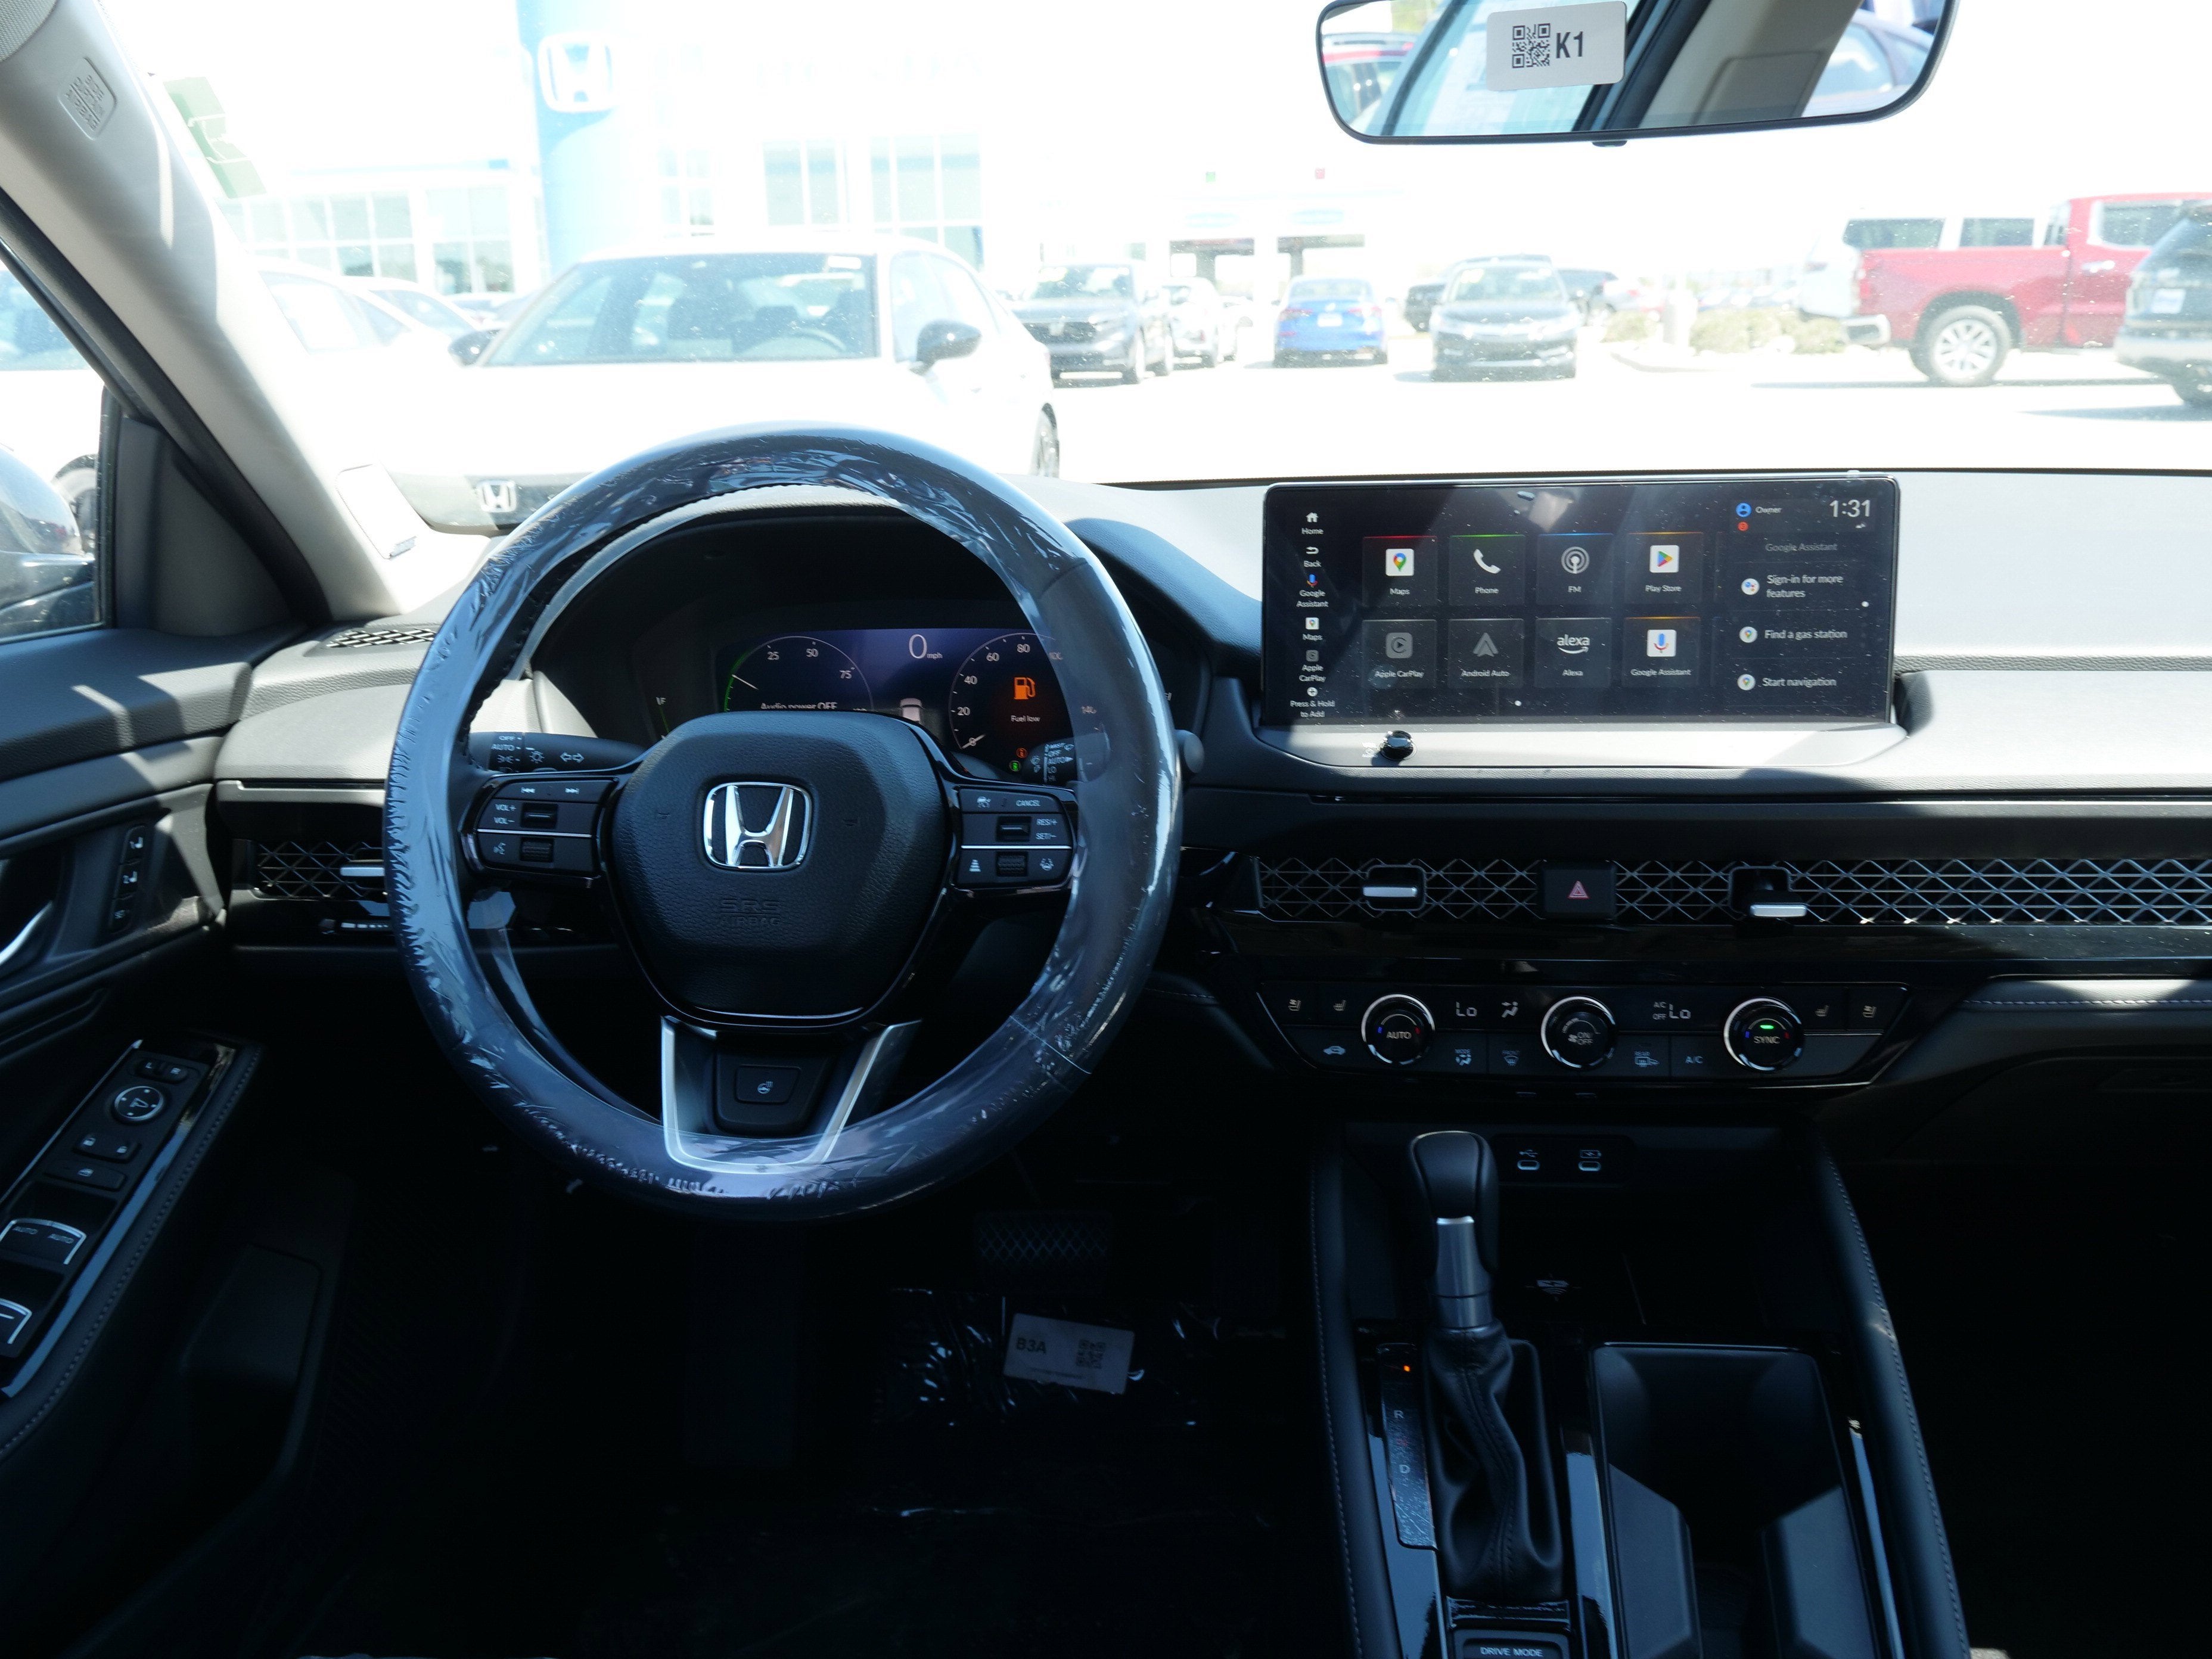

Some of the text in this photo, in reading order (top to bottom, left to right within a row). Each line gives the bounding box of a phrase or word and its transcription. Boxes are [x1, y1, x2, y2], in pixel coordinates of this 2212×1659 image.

[1556, 31, 1583, 58] K1
[1756, 506, 1782, 514] Owner
[1829, 499, 1871, 517] 1:31
[1765, 542, 1837, 553] Google Assistant
[1767, 574, 1843, 586] Sign-in for more
[1299, 589, 1326, 598] Google
[1390, 587, 1410, 596] Maps
[1475, 586, 1499, 595] Phone
[1645, 584, 1682, 594] Play Store
[1766, 589, 1806, 598] features
[1303, 633, 1323, 642] Maps
[1557, 634, 1590, 646] alexa
[1765, 629, 1788, 639] Find
[1795, 632, 1812, 642] gas
[1814, 629, 1847, 639] station
[909, 634, 927, 658] 0
[1017, 644, 1030, 653] 80
[768, 651, 779, 661] 25
[806, 648, 819, 657] 50
[987, 653, 1000, 662] 60
[1302, 664, 1324, 672] Apple
[1631, 667, 1691, 678] Google Assistant
[840, 670, 852, 679] 75
[1375, 669, 1424, 679] Apple CarPlay
[1461, 669, 1509, 678] Android Auto
[964, 676, 978, 685] 40
[1298, 675, 1326, 683] CarPlay
[1762, 676, 1837, 689] Start navigation
[957, 707, 971, 716] 20
[720, 899, 781, 913] SRS
[1456, 1002, 1477, 1017] Lo
[1669, 1004, 1691, 1020] Lo
[1754, 1036, 1781, 1044] SYNC
[13, 1226, 38, 1235] AUTO
[48, 1234, 74, 1244] AUTO
[1017, 1338, 1046, 1354] B3A
[1394, 1410, 1404, 1419] R
[1399, 1464, 1411, 1474] D
[1480, 1646, 1543, 1657] DRIVE MODE
